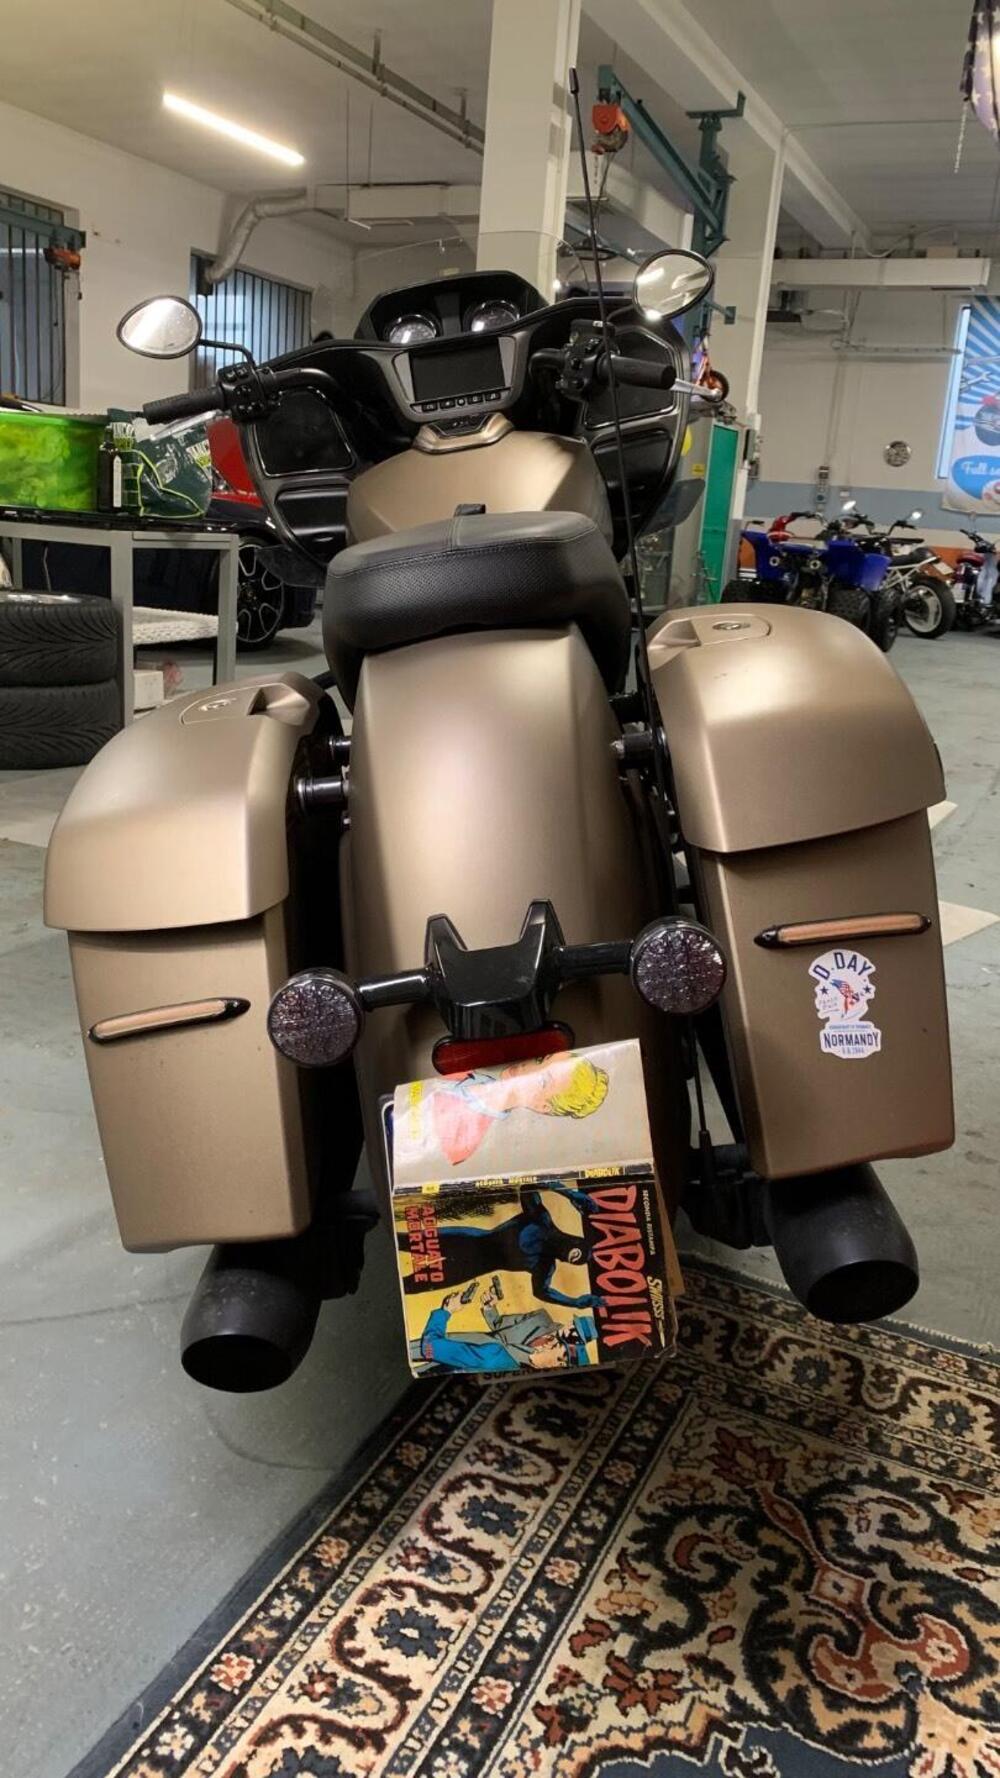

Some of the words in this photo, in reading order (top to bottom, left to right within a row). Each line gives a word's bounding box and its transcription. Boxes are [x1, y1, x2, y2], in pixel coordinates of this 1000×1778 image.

[833, 951, 872, 976] DAY
[823, 1032, 879, 1048] NORMANDY
[405, 1205, 429, 1284] MORTALE
[421, 1202, 445, 1283] AGGUATO
[587, 1184, 652, 1348] DIABOLIK
